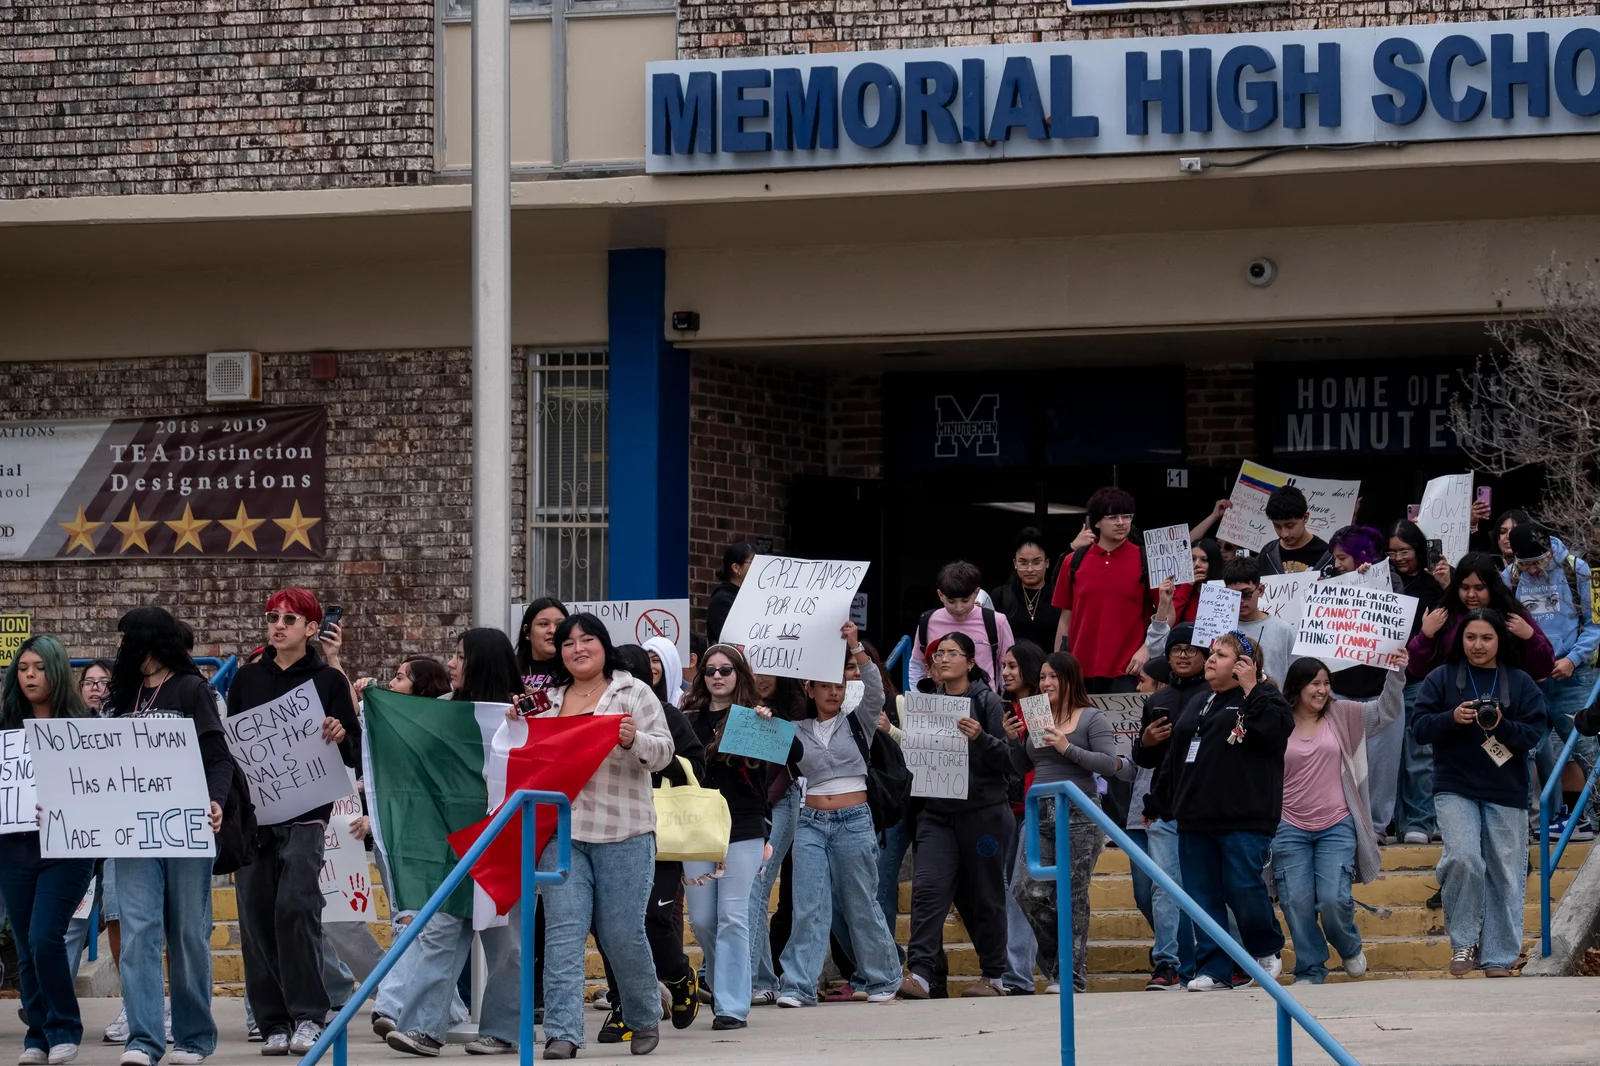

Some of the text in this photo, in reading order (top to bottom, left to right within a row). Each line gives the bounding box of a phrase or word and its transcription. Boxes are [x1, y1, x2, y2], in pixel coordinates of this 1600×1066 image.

[651, 27, 1600, 157] MEMORIAL HIGH SCHO
[1298, 376, 1388, 409] HOME
[1408, 373, 1449, 406] OF
[156, 420, 200, 434] 2018
[221, 418, 268, 433] 2019
[937, 421, 998, 436] MINUTEMEN
[110, 443, 313, 463] TEA Distinction
[111, 471, 312, 496] Designations
[1447, 475, 1470, 496] THE
[1311, 490, 1325, 502] you
[1332, 488, 1355, 498] don't
[1145, 525, 1188, 545] OUR VOICES
[1441, 522, 1455, 533] OF
[1147, 540, 1183, 558] CAN ONLY BE
[757, 557, 861, 590] GRITAMOS
[1149, 555, 1179, 588] HEARD
[1202, 585, 1214, 594] YOU
[1320, 585, 1337, 596] AM
[1340, 587, 1355, 597] NO
[1357, 589, 1399, 604] LONGER
[765, 595, 819, 617] POR LOS
[1305, 595, 1404, 615] ACCEPTING THE THINGS
[0, 618, 26, 632] ION
[1307, 604, 1406, 628] I CANNOT CHANGE
[748, 622, 802, 640] QUE NO
[1301, 618, 1406, 641] I AM CHANGING THE
[1299, 630, 1382, 651] THINGS I CANNOT
[0, 650, 15, 660] RA
[748, 644, 803, 671] PUEDEN!
[942, 697, 970, 712] FORGET
[1026, 694, 1044, 708] FIGHT
[1036, 704, 1050, 716] OUR
[906, 713, 925, 729] THE
[927, 715, 955, 730] HANDS
[1117, 710, 1142, 722] IS
[35, 723, 65, 751] NO
[67, 722, 122, 751] DECENT
[132, 722, 187, 749] HUMAN
[281, 718, 319, 748] the
[902, 729, 933, 749] BUILT
[942, 735, 967, 752] CITY
[938, 752, 968, 767] FORGET
[69, 766, 173, 795] HAS A HEART
[915, 769, 965, 796] LAMO
[660, 810, 702, 828] Juicy
[47, 808, 209, 851] MADE OF ICE
